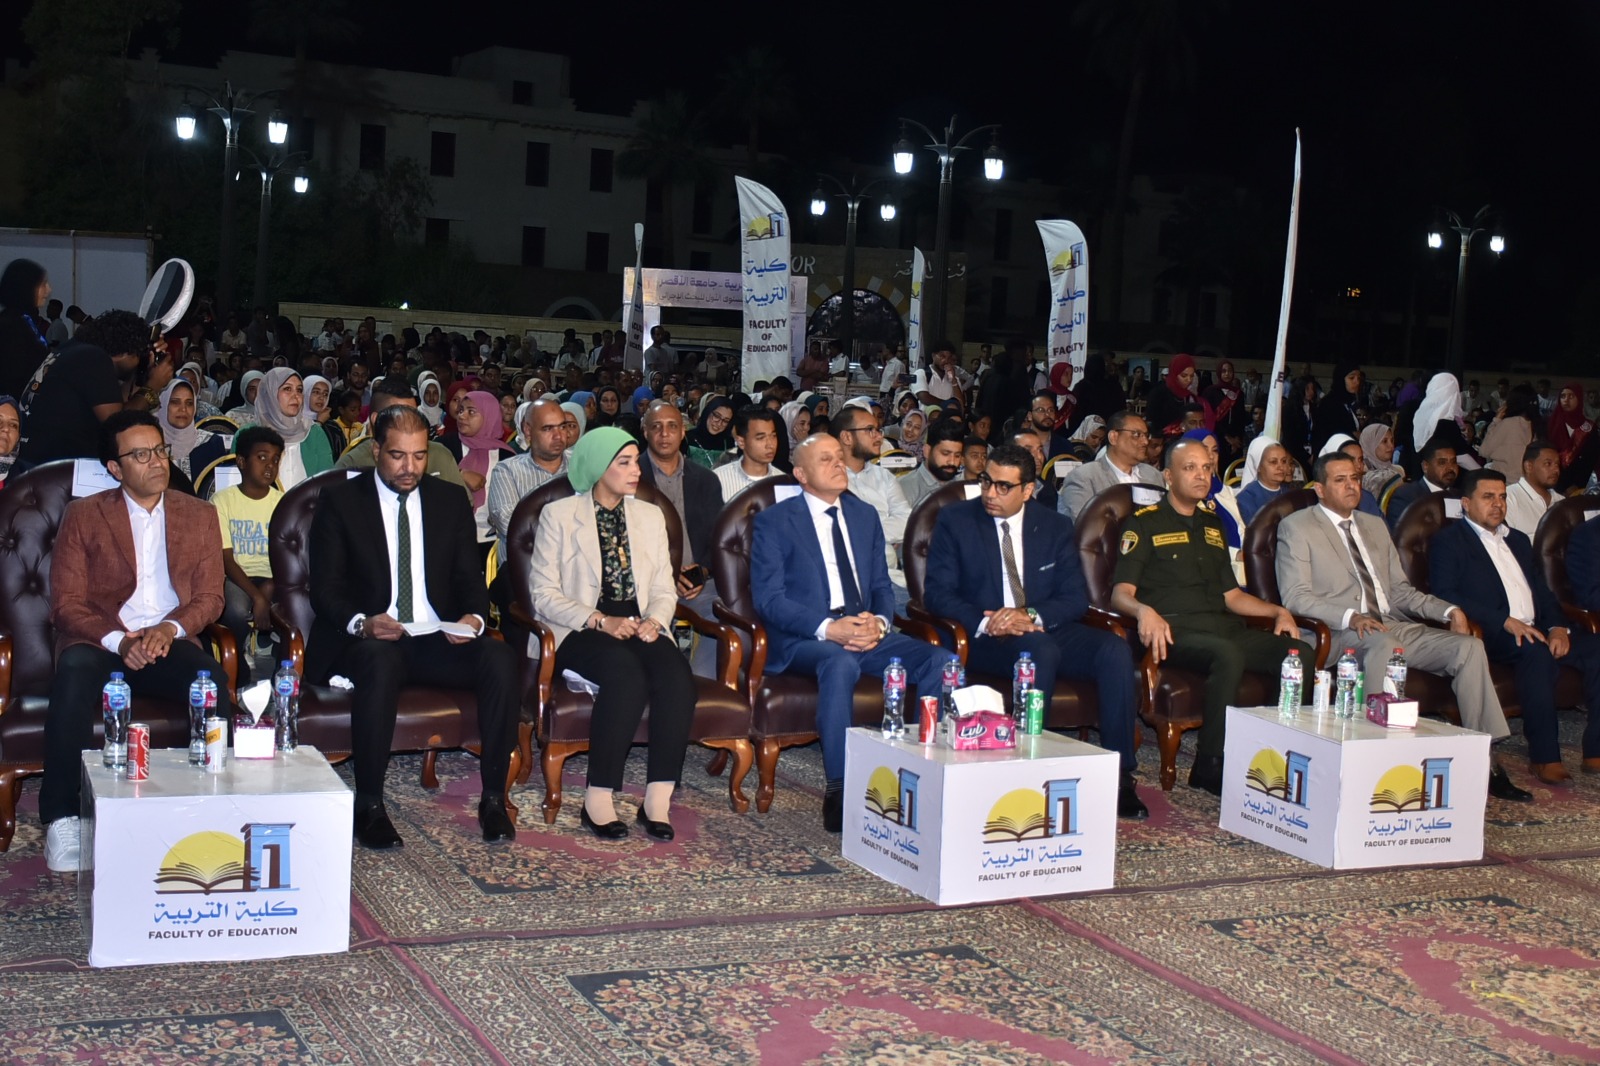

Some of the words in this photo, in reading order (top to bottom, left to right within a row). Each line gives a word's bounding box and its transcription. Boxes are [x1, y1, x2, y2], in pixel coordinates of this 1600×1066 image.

[746, 258, 787, 277] كلية
[690, 278, 717, 290] جامعة
[745, 286, 788, 307] التربية
[749, 318, 787, 329] FACULTY
[761, 333, 772, 341] OF
[1243, 793, 1276, 816] التربية
[863, 816, 892, 840] التربية
[1240, 812, 1265, 826] FACULTY
[1274, 826, 1308, 844] EDUCATION
[1279, 807, 1308, 829] كلية
[1368, 818, 1412, 836] التربية
[1415, 817, 1452, 834] كلية
[893, 830, 919, 856] كلية
[1364, 840, 1397, 848] FACULTY
[1410, 837, 1451, 845] EDUCATION
[861, 837, 882, 852] FACULTY
[883, 848, 889, 856] OF
[890, 851, 918, 872] EDUCATION
[982, 847, 1034, 868] التربية
[1039, 843, 1082, 863] كلية
[978, 872, 1017, 882] FACULTY
[1019, 870, 1030, 878] OF
[1033, 865, 1082, 876] EDUCATION
[153, 901, 229, 924] التربية
[235, 900, 298, 921] كلية
[149, 930, 203, 939] FACULTY
[207, 929, 224, 937] OF
[228, 927, 298, 937] EDUCATION
